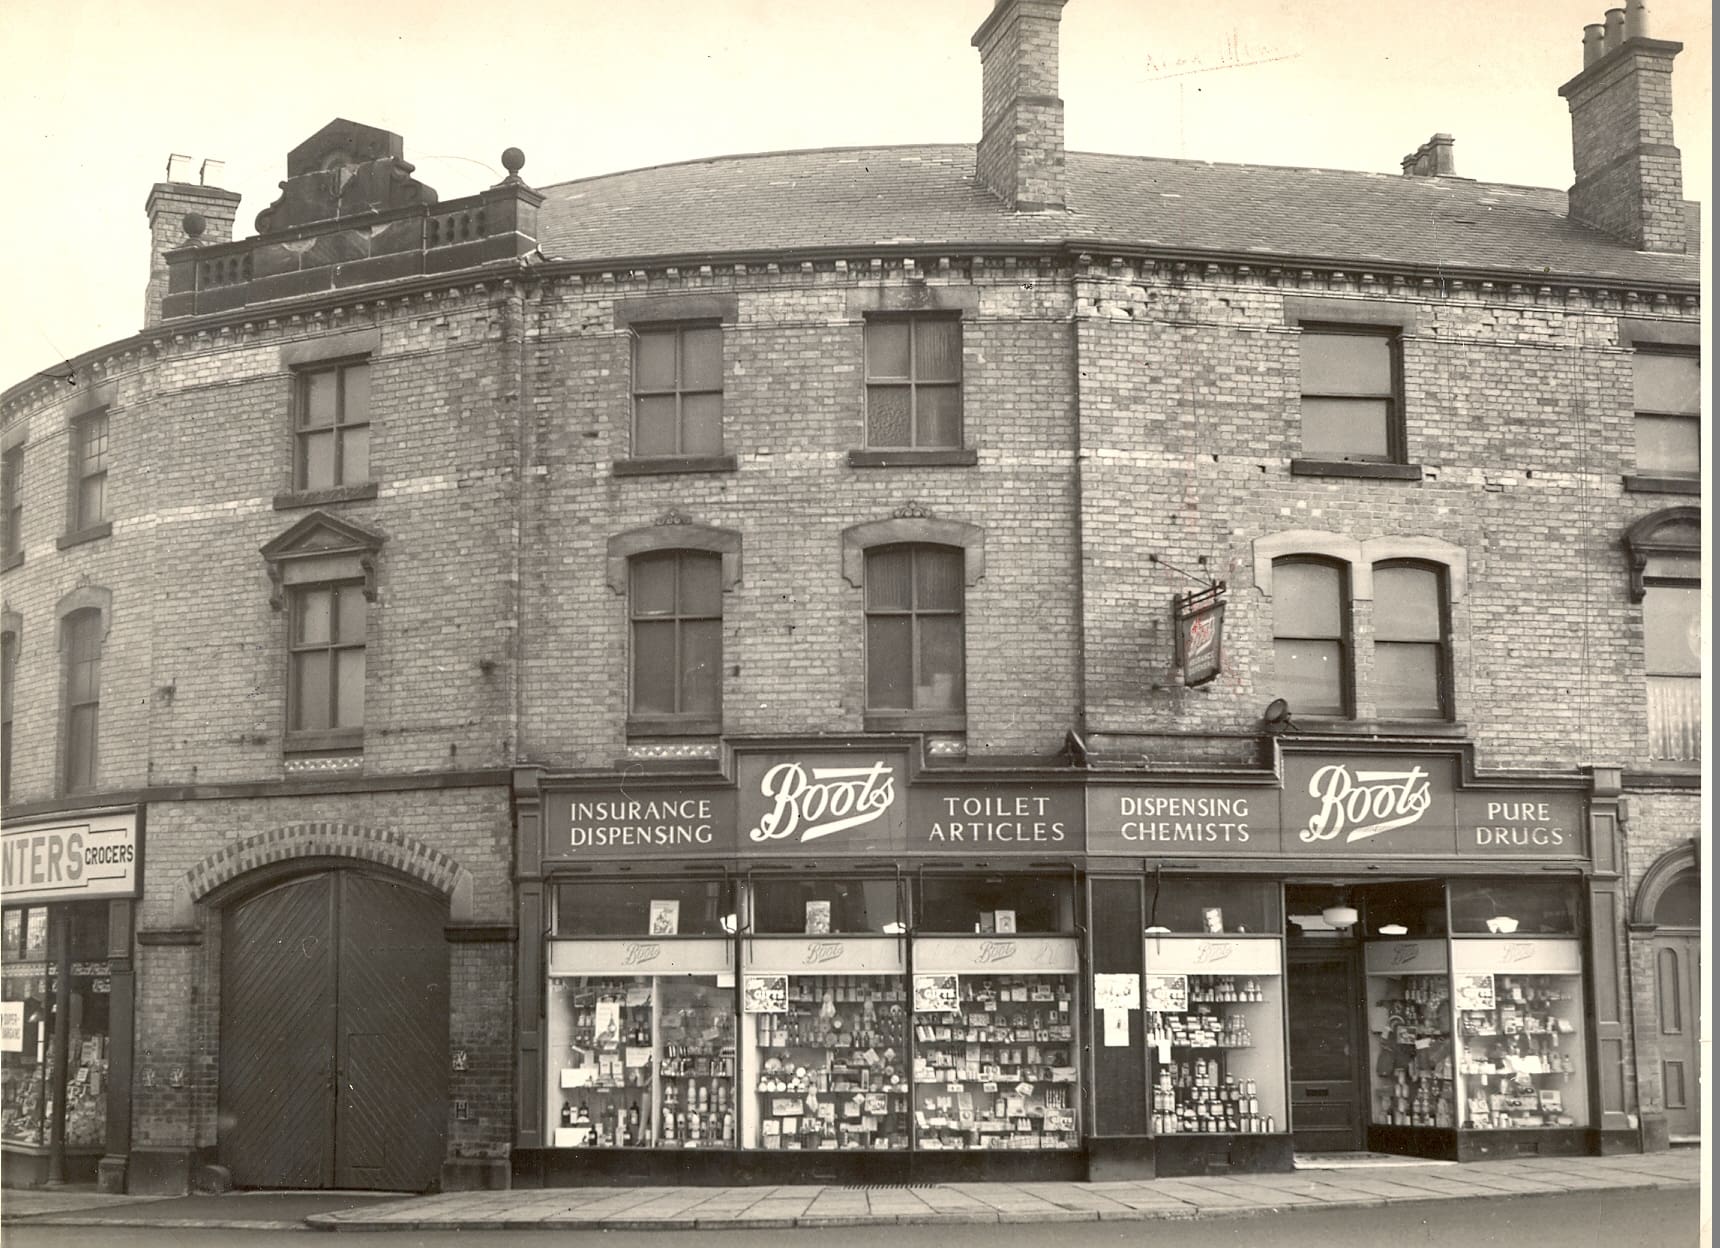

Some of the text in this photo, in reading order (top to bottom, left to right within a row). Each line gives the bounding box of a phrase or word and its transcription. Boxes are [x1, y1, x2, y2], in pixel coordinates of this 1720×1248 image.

[571, 800, 712, 821] INSURANCE
[750, 761, 895, 843] Boots
[943, 797, 1050, 816] TOILET
[1121, 797, 1249, 817] DISPENSING
[1300, 764, 1431, 843] Boots
[1487, 802, 1551, 821] PURE
[570, 825, 712, 846] DISPENSING
[929, 822, 1065, 841] ARTICLES
[1121, 822, 1249, 842] CHEMISTS
[1476, 826, 1564, 845] DRUGS
[1, 832, 84, 887] NTERS
